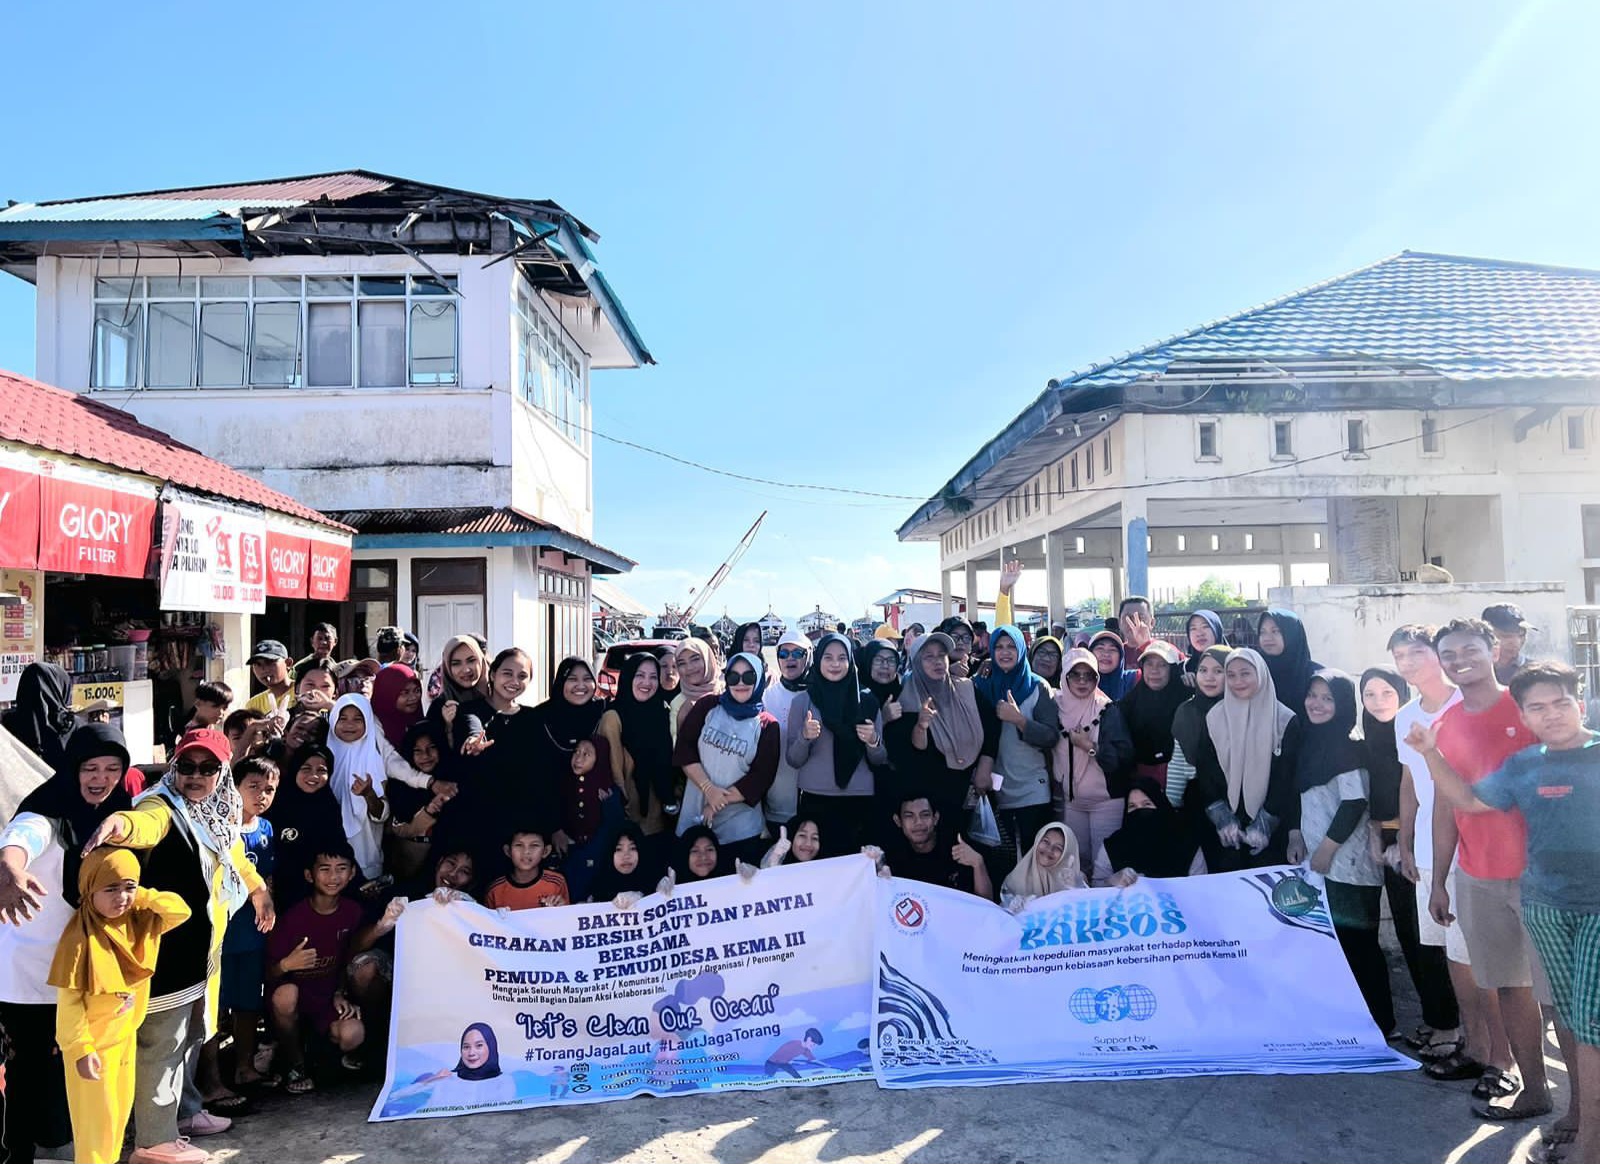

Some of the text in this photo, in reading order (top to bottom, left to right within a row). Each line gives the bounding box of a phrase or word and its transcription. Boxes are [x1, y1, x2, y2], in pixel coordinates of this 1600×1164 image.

[59, 503, 132, 544] GLORY
[80, 546, 117, 564] FILTER
[181, 556, 207, 573] PILIHAN
[270, 547, 306, 575] GLORY
[278, 578, 300, 589] FILTER
[2, 665, 11, 674] ADA
[6, 655, 19, 664] MILD
[468, 892, 815, 953] GERAKAN BERSIH LAUT DAN PANTAI
[577, 894, 708, 932] BAKTI SOSIAL
[1018, 906, 1188, 951] BAKSOS
[484, 930, 807, 985] PEMUDA & PEMUDI DESA KEMA III
[598, 932, 691, 965] BERSAMA
[962, 938, 1240, 965] Meningkatkan kepedulian masyarakat terhadap kebersihan
[962, 948, 1248, 976] laut dan membangun kebiasaan kebersihan pemuda Kema III
[492, 984, 530, 998] Mengajak
[530, 986, 562, 995] Seluruh
[562, 982, 609, 997] Masyarakat
[618, 976, 660, 989] Komunitas
[666, 968, 697, 981] Lembaga
[704, 960, 744, 974] Organisasi
[752, 951, 795, 966] Perorangan
[492, 994, 516, 1004] Untuk
[516, 994, 538, 1004] ambil
[540, 995, 568, 1006] Bagian
[568, 994, 594, 1004] Dalam
[594, 992, 612, 1002] Aksi
[613, 985, 654, 1000] kolaborasi
[586, 1012, 650, 1038] Clean
[525, 1024, 781, 1062] #TorangJagaLaut #LautJagaTorang
[1094, 1036, 1132, 1045] Support
